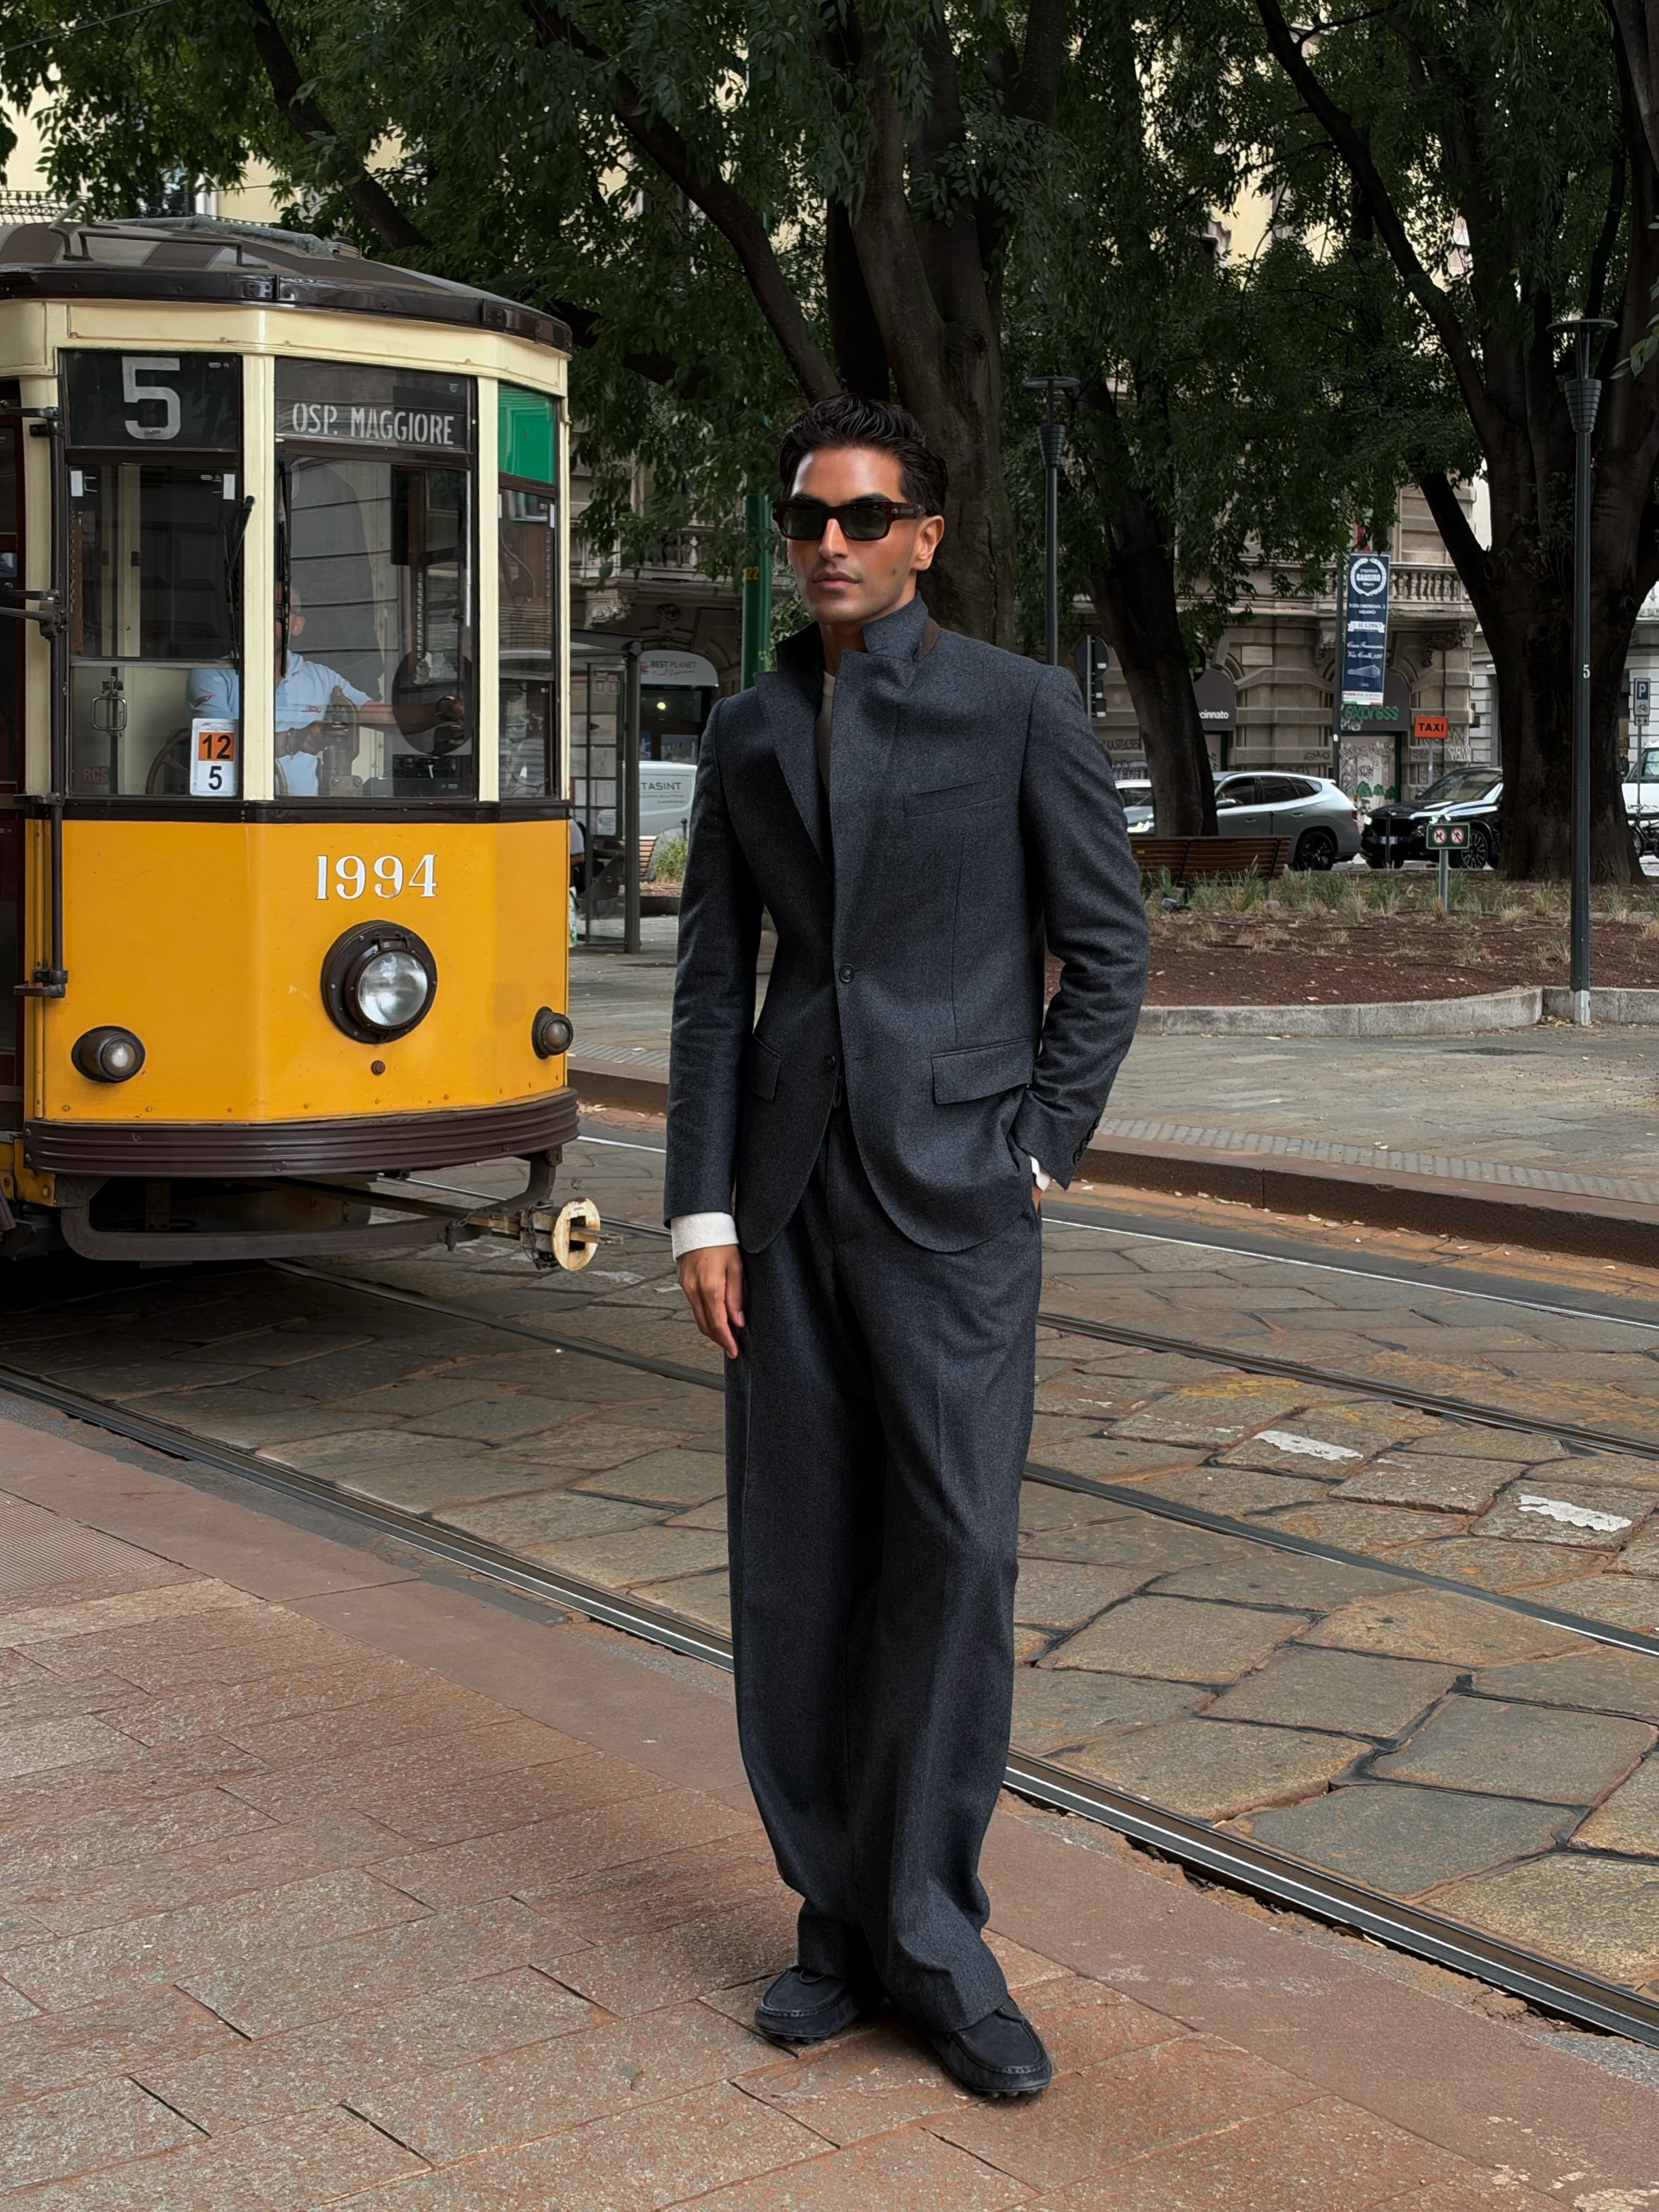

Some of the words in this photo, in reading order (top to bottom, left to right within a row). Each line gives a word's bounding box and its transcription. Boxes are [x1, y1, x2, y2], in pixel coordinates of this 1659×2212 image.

[122, 356, 180, 440] 5
[292, 403, 338, 435] OSP.
[351, 407, 455, 445] MAGGIORE
[1583, 664, 1590, 679] 5
[1639, 684, 1646, 698] P
[1418, 723, 1444, 732] TAXI
[202, 735, 231, 759] 12
[208, 765, 222, 791] 5
[639, 782, 681, 791] TASINT
[314, 854, 438, 900] 1994
